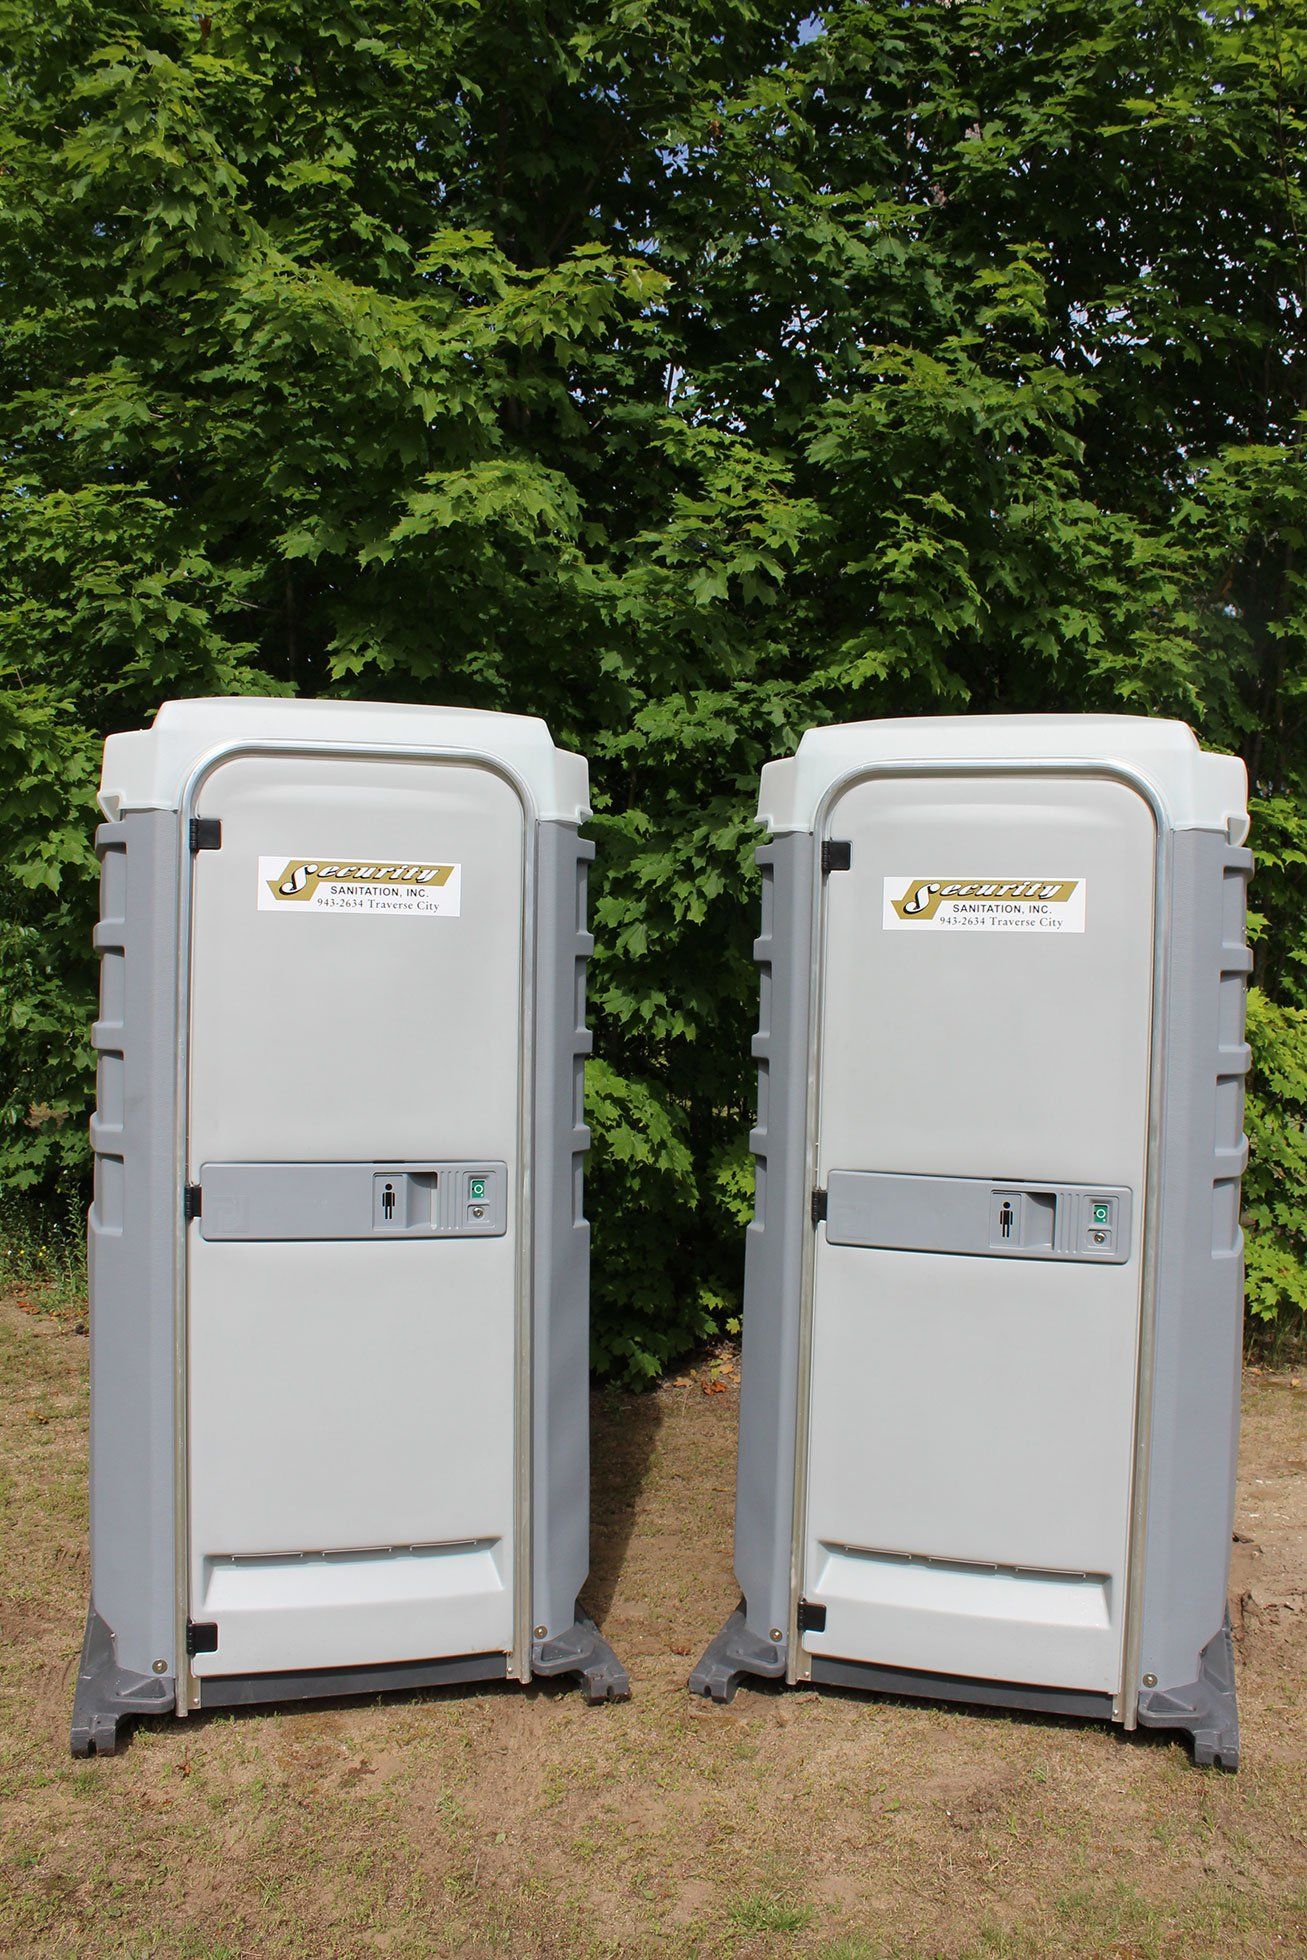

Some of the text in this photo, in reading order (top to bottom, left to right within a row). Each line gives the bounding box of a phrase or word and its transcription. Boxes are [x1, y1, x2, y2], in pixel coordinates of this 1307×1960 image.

[279, 863, 440, 896] Security
[330, 886, 429, 898] SANITATION, INC.
[903, 881, 1064, 915] Security
[317, 898, 440, 913] 943-2634 Traverse City
[953, 904, 1052, 914] SANITATION, INC.
[939, 916, 1063, 930] 943-2634 Traverse City
